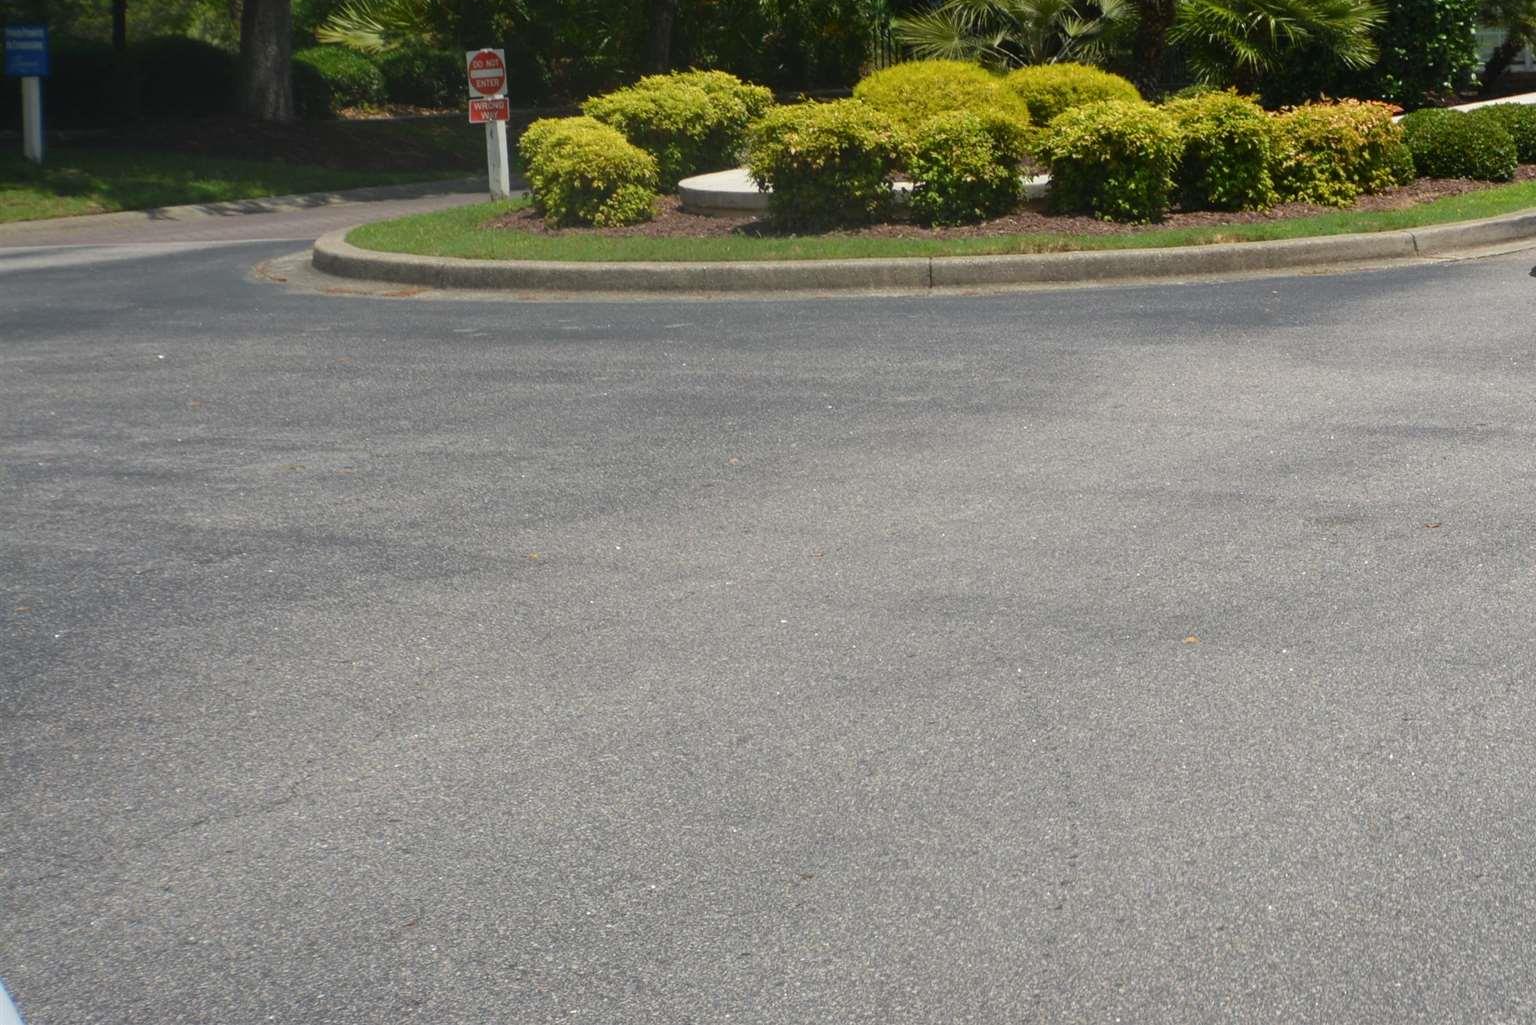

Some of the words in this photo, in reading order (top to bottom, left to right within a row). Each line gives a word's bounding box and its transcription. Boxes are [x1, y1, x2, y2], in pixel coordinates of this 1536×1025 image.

[472, 59, 484, 69] DO
[475, 78, 500, 89] ENTER
[473, 102, 505, 111] WRONG
[480, 111, 498, 120] WAY
